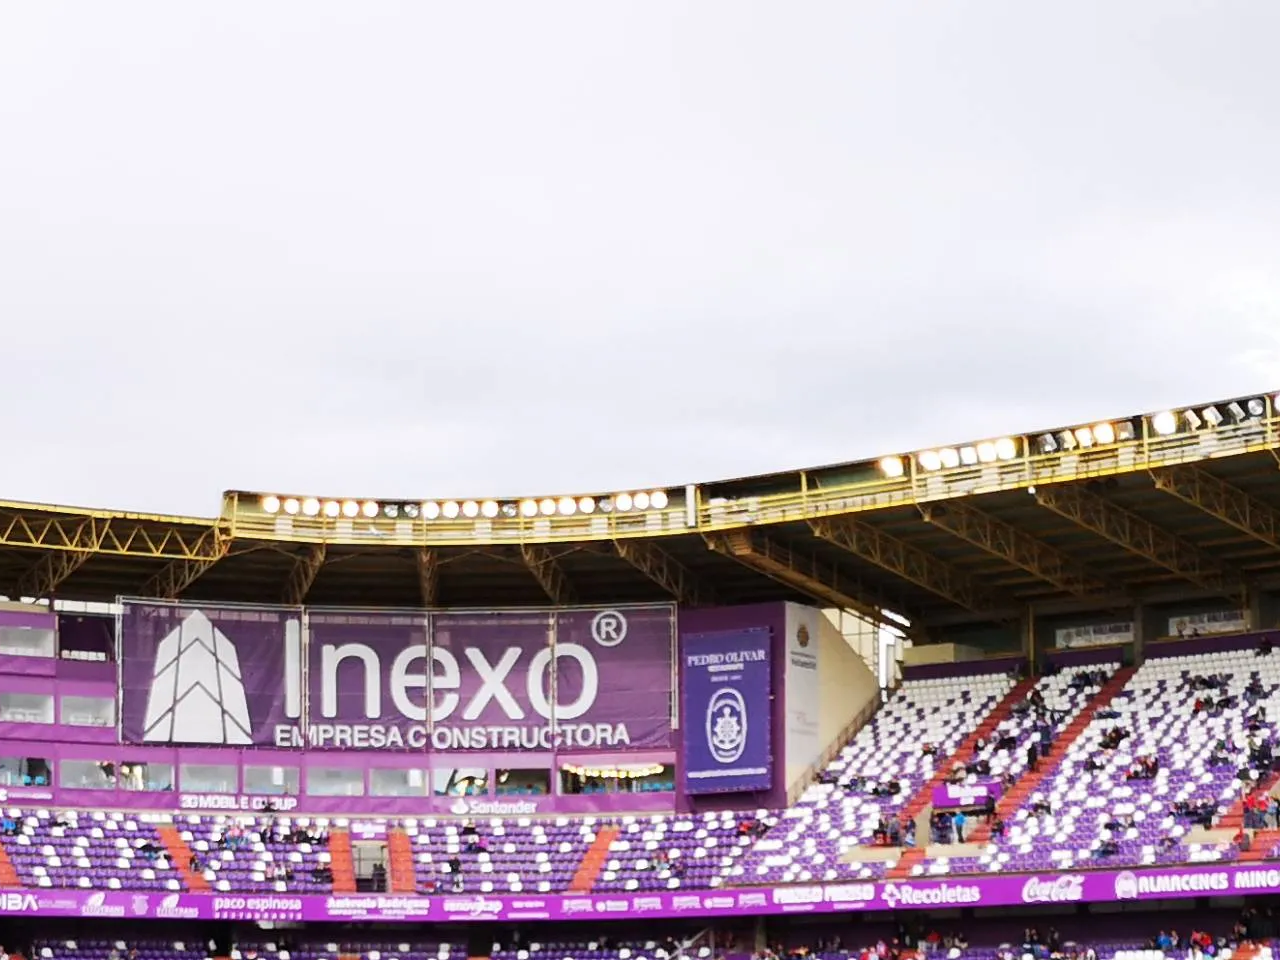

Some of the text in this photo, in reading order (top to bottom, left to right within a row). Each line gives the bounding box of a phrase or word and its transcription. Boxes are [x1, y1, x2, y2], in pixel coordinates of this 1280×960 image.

[687, 649, 765, 667] PEDRO OLIVAR
[284, 618, 599, 722] Inexo
[275, 723, 630, 750] EMPRESA CONSTRUCTORA
[1138, 872, 1228, 893] ALMACENES
[901, 884, 981, 905] Recoletas
